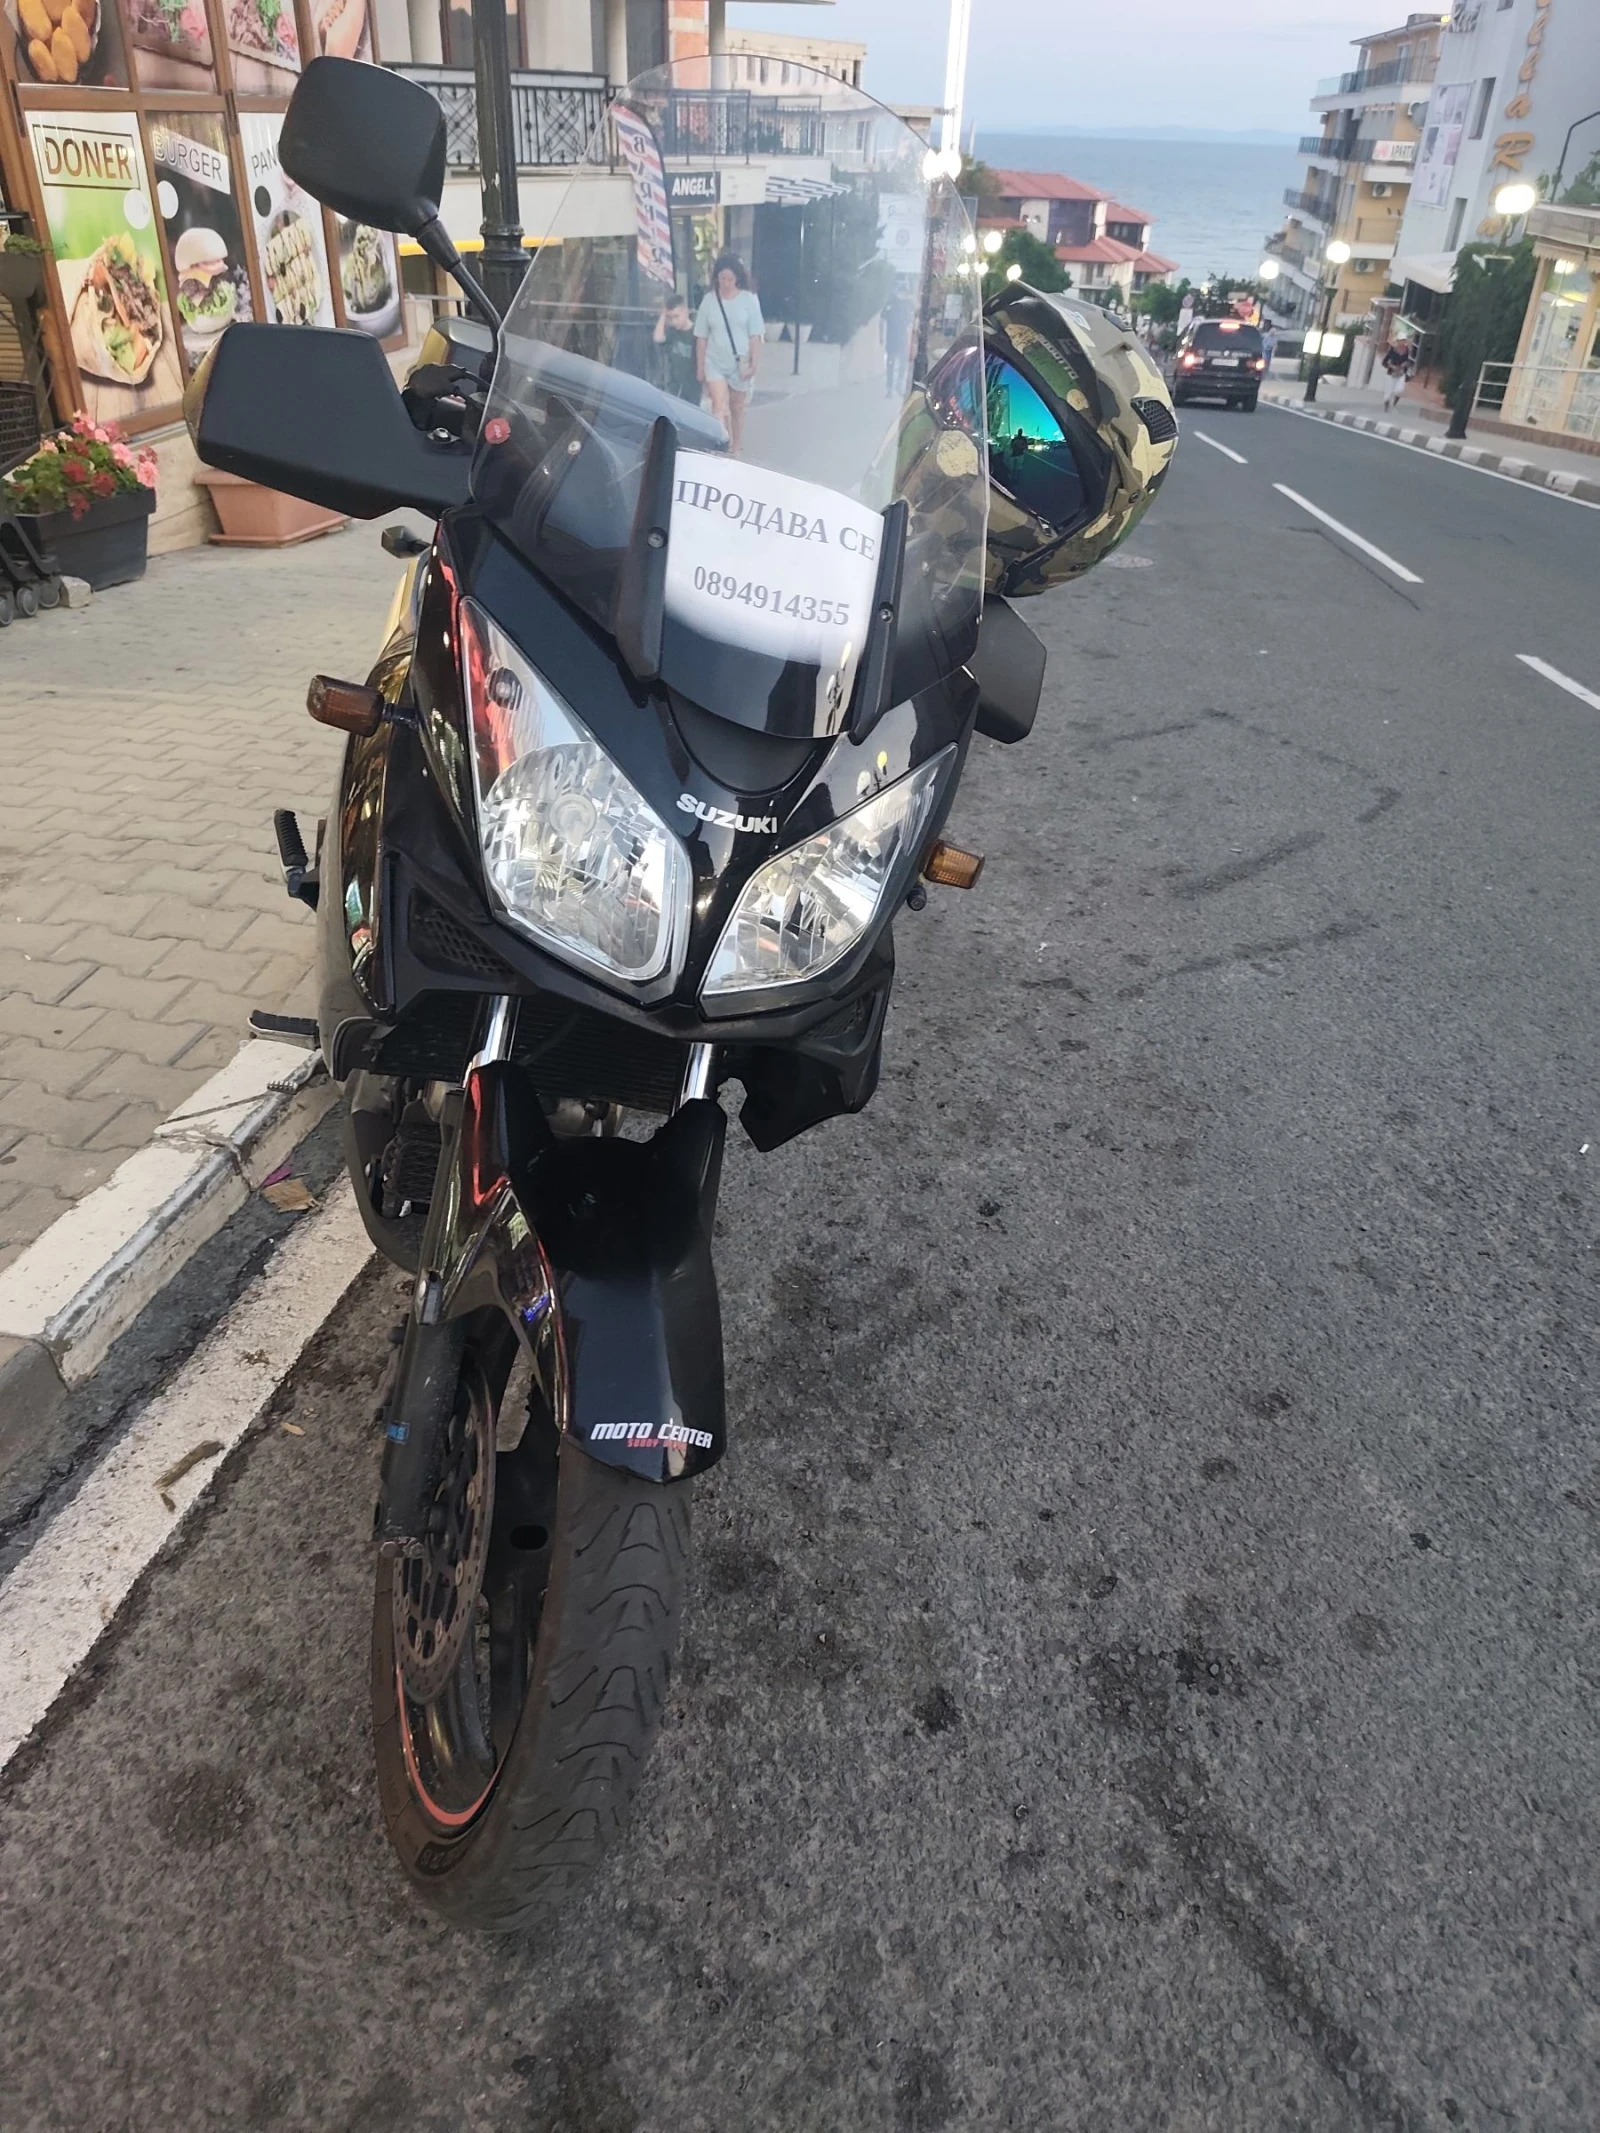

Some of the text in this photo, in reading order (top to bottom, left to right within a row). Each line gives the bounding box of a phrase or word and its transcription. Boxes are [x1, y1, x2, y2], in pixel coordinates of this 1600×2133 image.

[44, 136, 133, 180] DONER
[153, 130, 223, 182] BURGER
[251, 146, 280, 178] PAN
[675, 479, 876, 561] ПРОДАВА СЕ
[693, 565, 850, 626] 0894914355
[676, 793, 777, 834] SUZUKI
[590, 1422, 653, 1440] MOTO
[657, 1423, 713, 1449] CENTER
